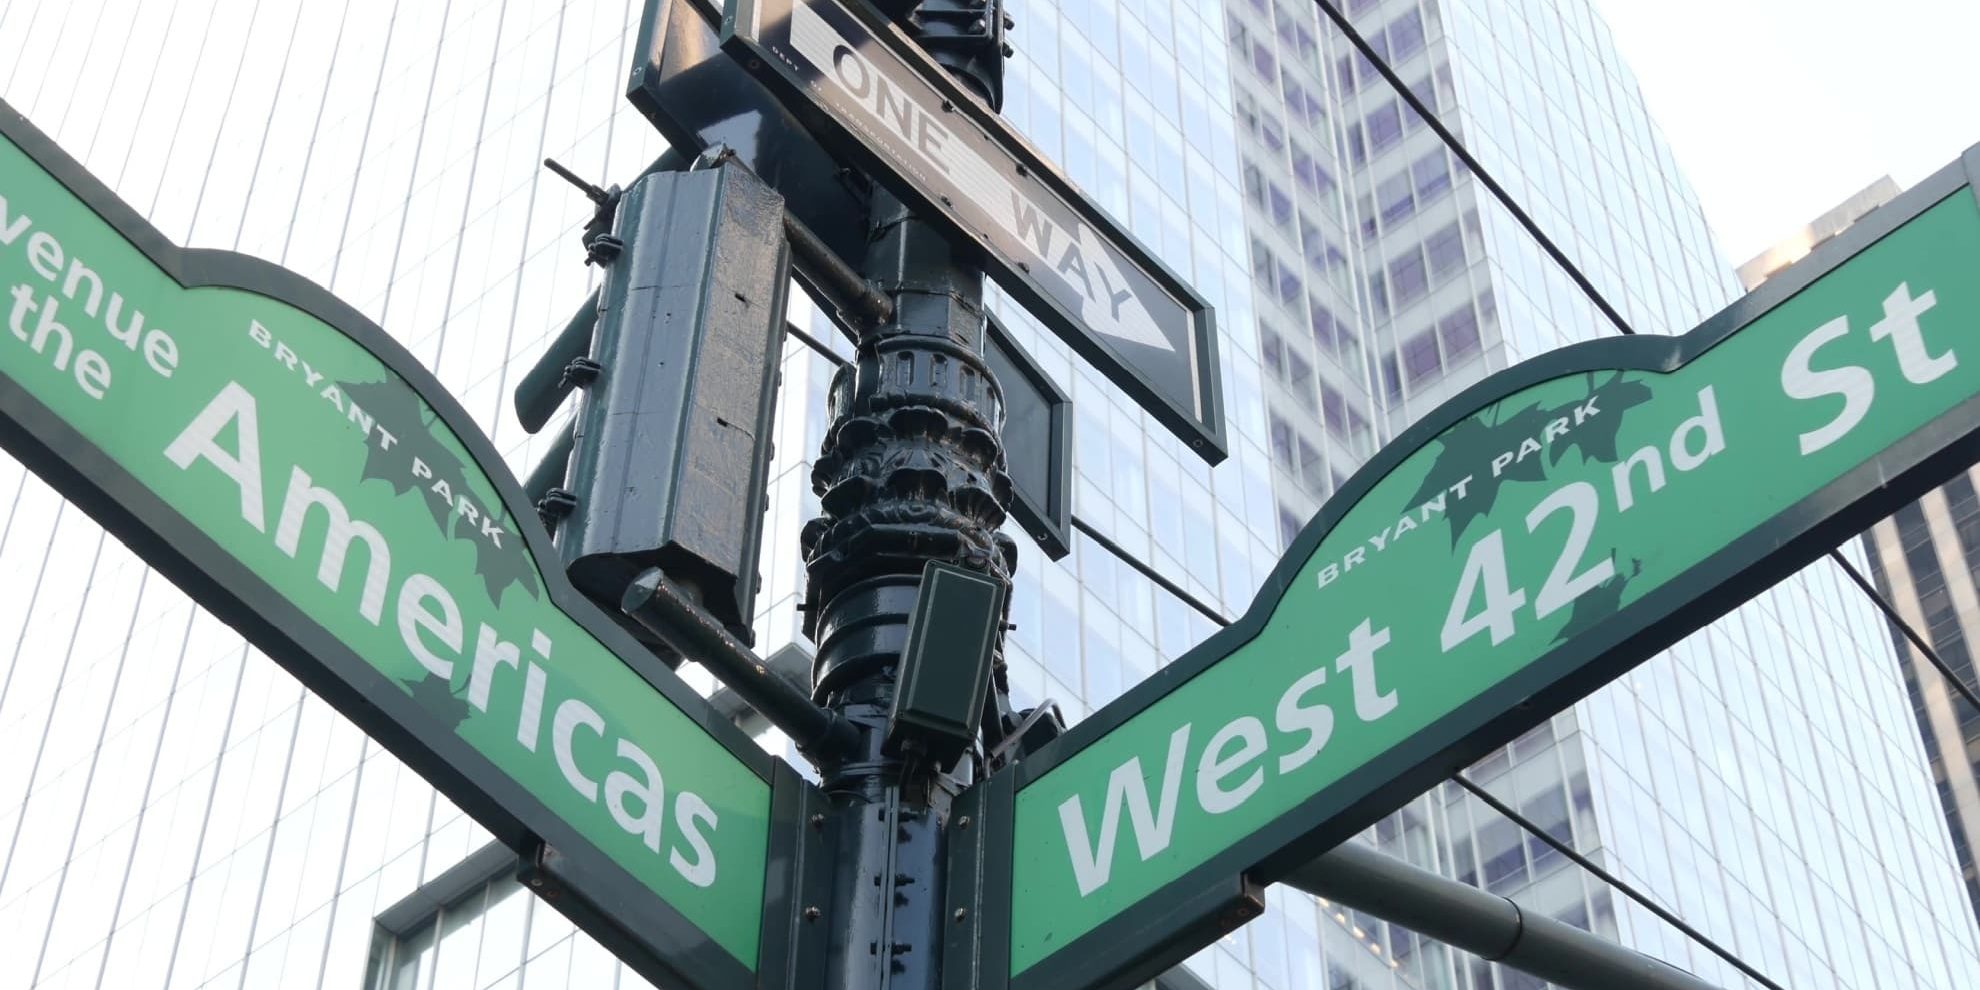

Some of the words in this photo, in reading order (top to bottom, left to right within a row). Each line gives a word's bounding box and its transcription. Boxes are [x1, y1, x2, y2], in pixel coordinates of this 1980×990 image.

[833, 44, 950, 175] ONE
[1010, 188, 1133, 323] WAY
[9, 283, 112, 400] the
[249, 319, 399, 452] BRYANT
[411, 456, 506, 550] PARK
[1058, 615, 1399, 897] West
[1440, 387, 1726, 653] 42nd
[1781, 282, 1959, 456] St
[1316, 475, 1473, 590] BRYANT
[1491, 396, 1602, 478] PARK
[163, 380, 719, 888] Americas
